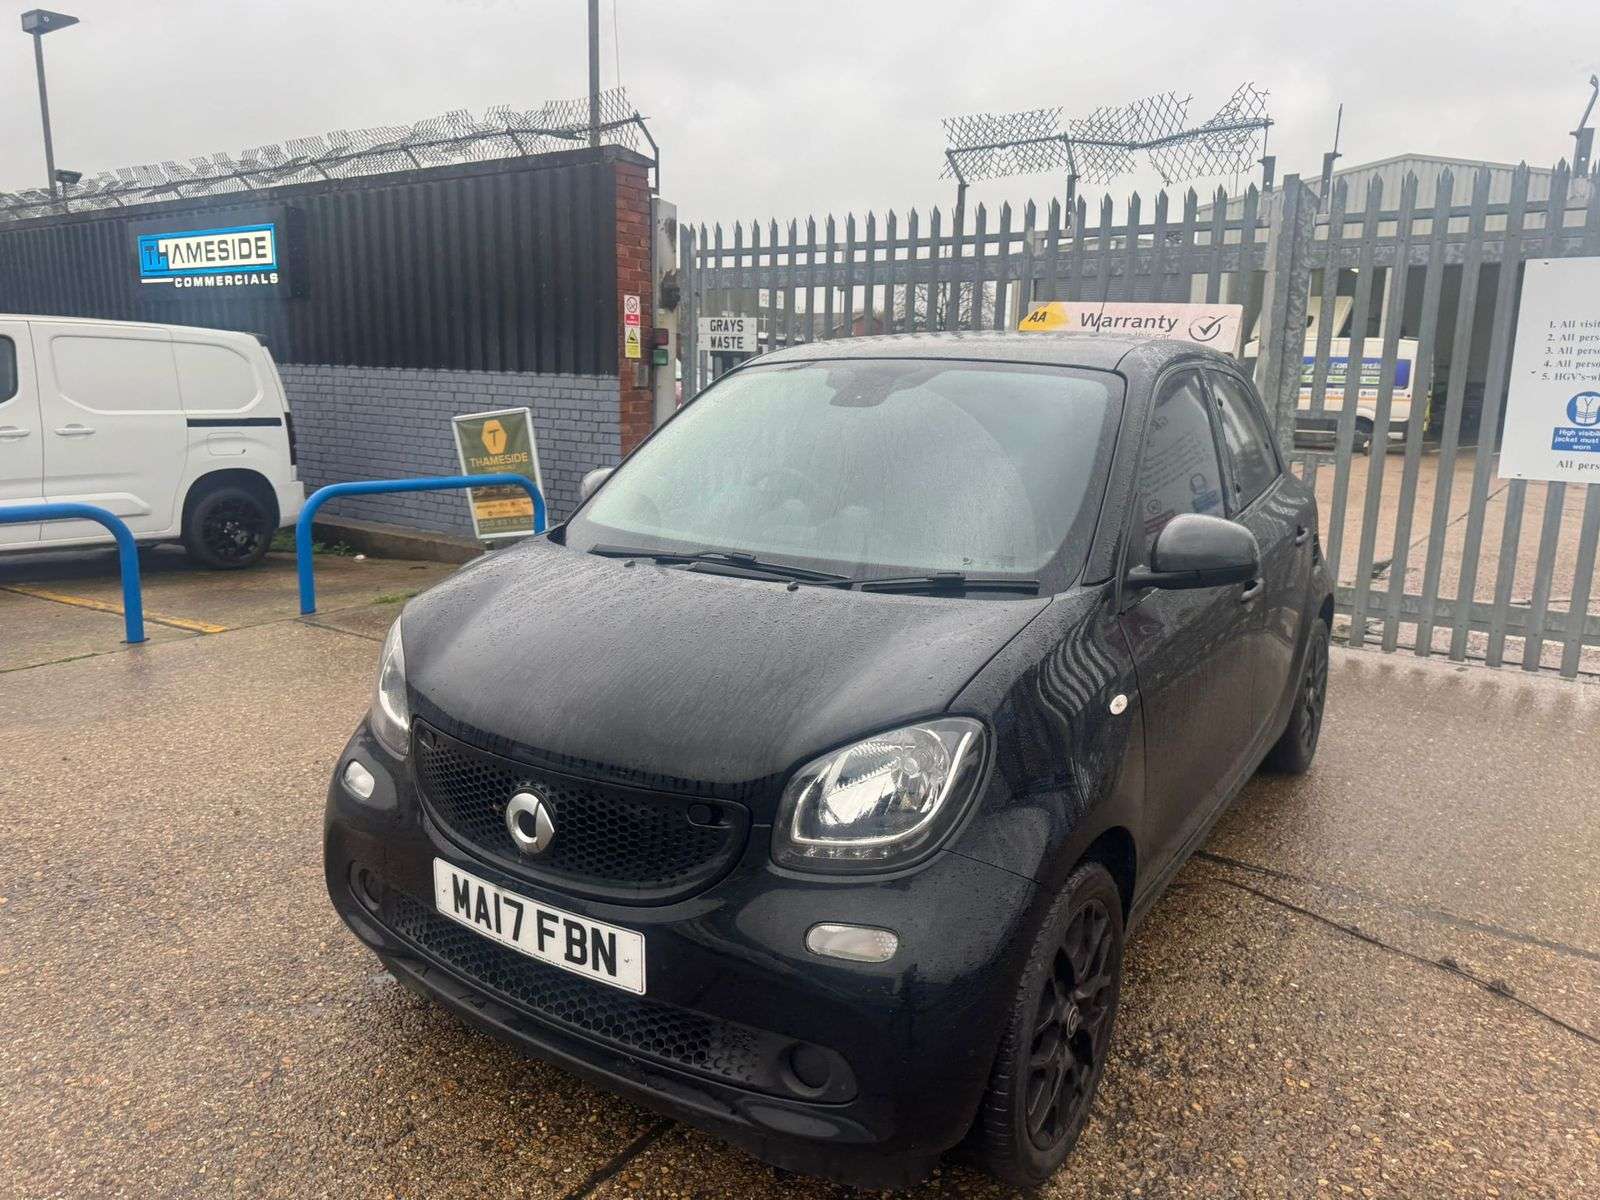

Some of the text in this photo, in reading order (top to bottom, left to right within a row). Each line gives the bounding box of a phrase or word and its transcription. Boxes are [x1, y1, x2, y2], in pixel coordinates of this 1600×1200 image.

[143, 236, 267, 265] THAMESIDE
[174, 272, 279, 287] COMMERCIALS
[710, 319, 744, 332] GRAYS
[1028, 311, 1179, 332] AA Warranty
[1560, 320, 1576, 329] All
[710, 336, 744, 349] WASTE
[1547, 333, 1556, 342] 2.
[1560, 333, 1575, 342] All
[1545, 347, 1553, 355] 3.
[1558, 346, 1573, 355] All
[1543, 360, 1552, 368] 4.
[1556, 360, 1572, 368] All
[1541, 373, 1551, 381] 5.
[487, 429, 500, 447] T
[470, 452, 528, 467] THAMESIDE
[1556, 460, 1573, 469] All
[452, 872, 617, 978] MA17 FBN
